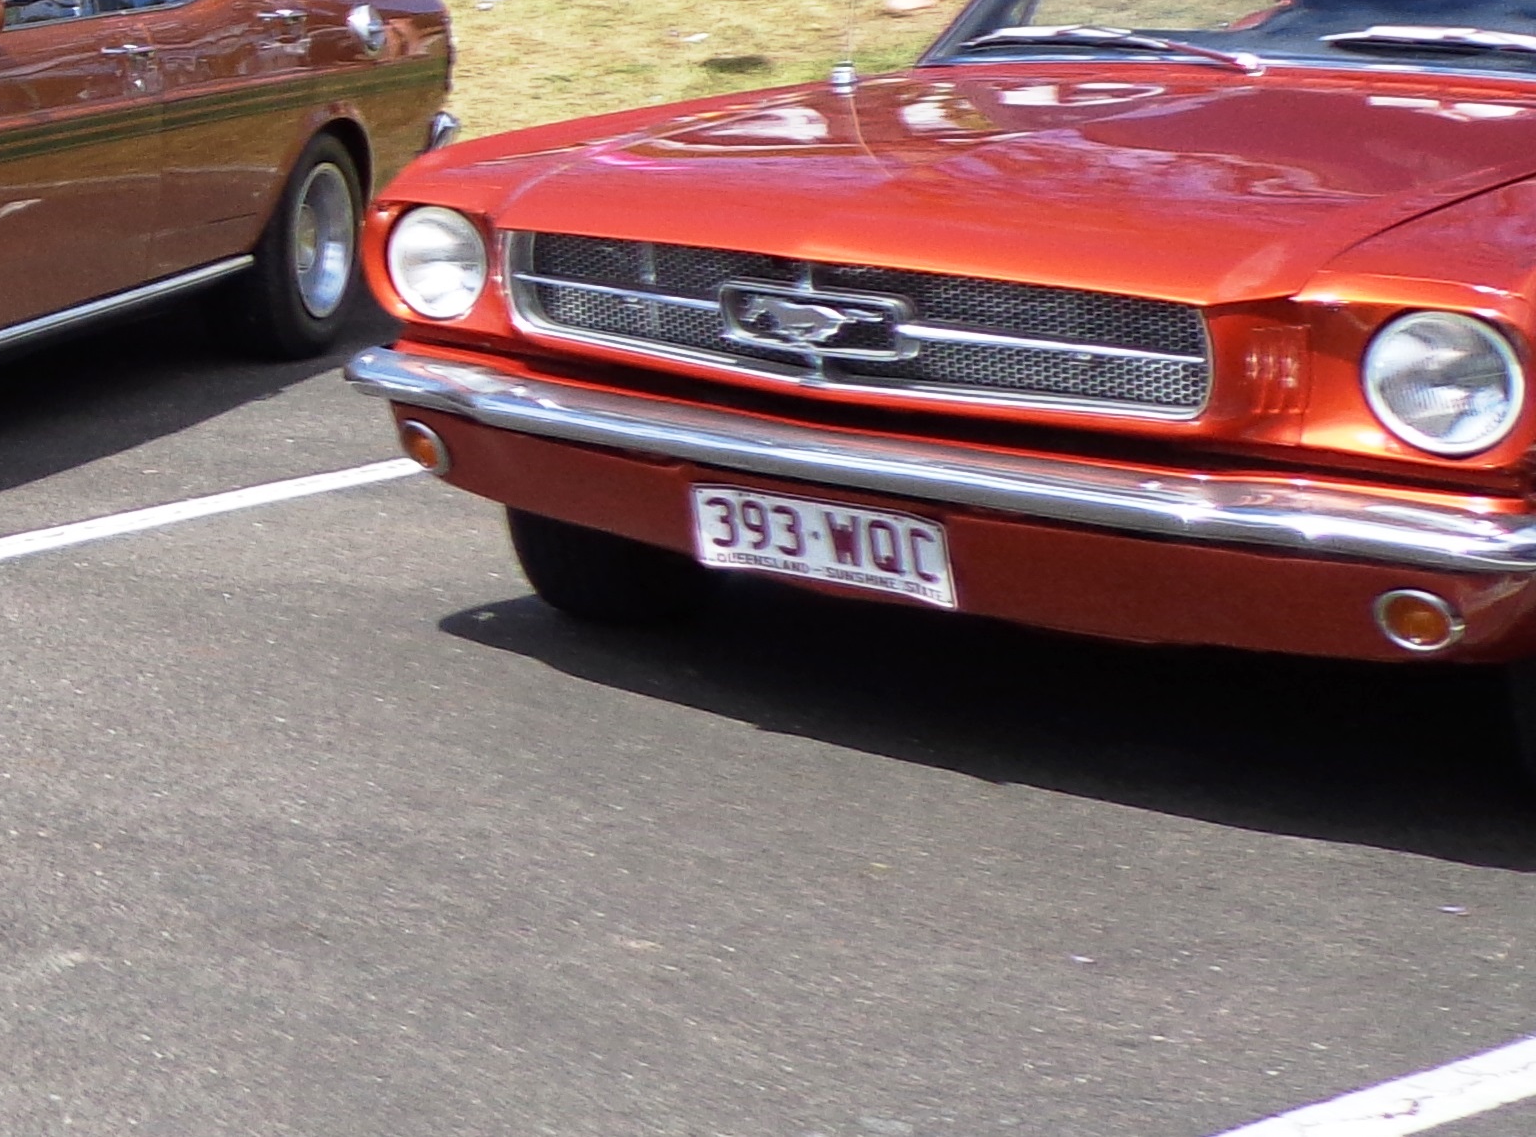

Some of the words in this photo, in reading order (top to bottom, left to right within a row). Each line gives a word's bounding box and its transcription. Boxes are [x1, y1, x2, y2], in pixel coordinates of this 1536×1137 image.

[716, 552, 811, 574] QUEENSLAND
[824, 566, 899, 590] SUNSHINE
[904, 580, 944, 599] STATE
